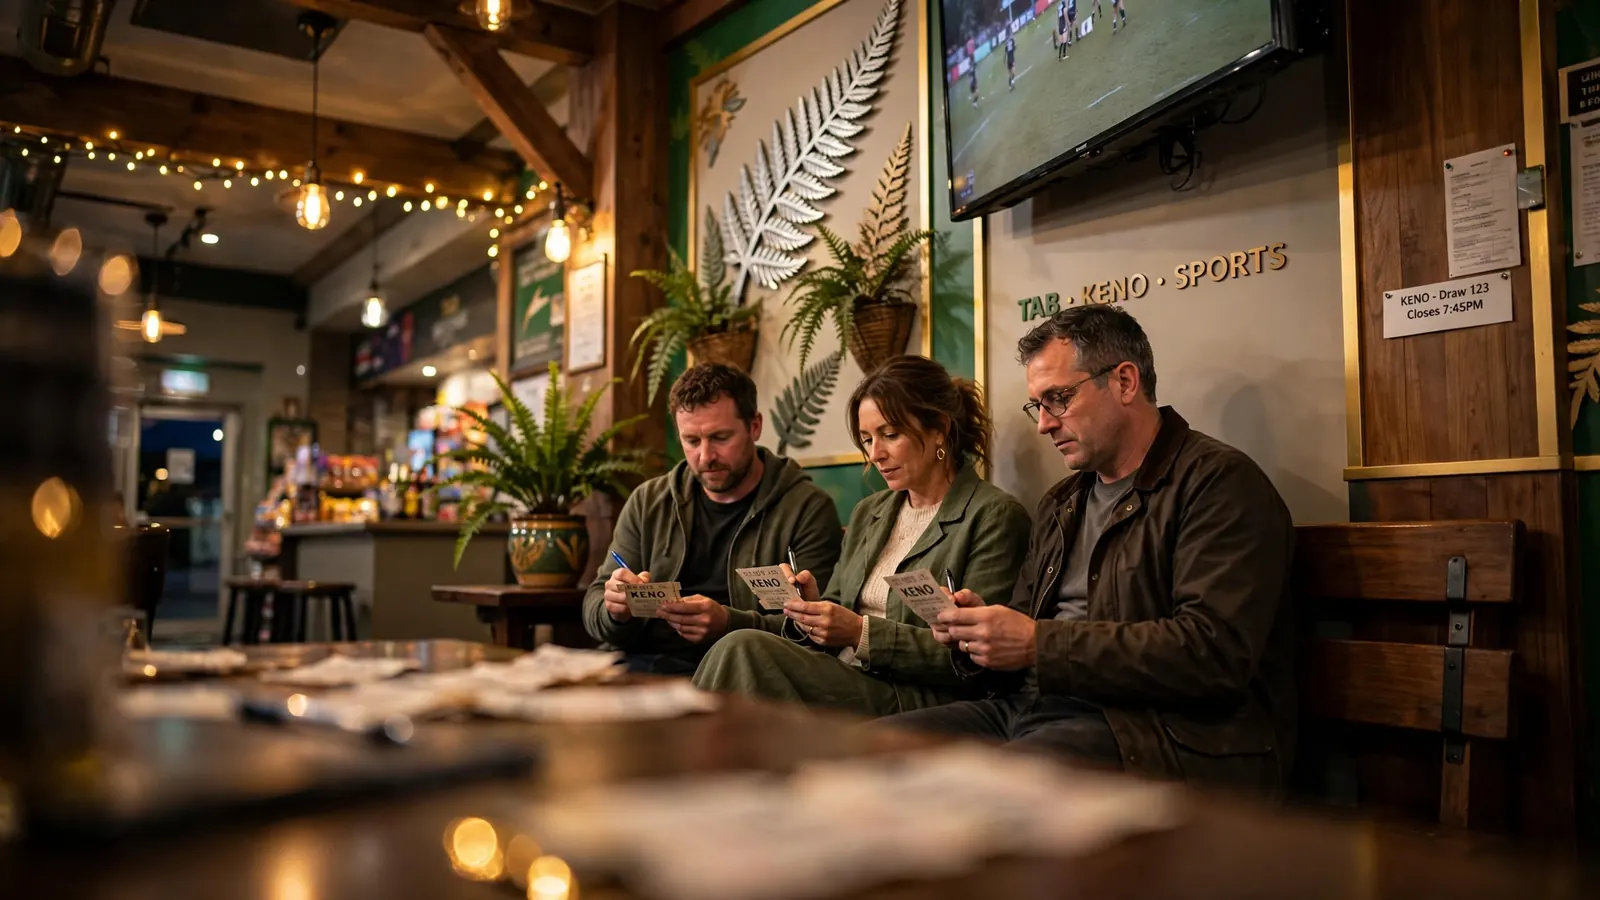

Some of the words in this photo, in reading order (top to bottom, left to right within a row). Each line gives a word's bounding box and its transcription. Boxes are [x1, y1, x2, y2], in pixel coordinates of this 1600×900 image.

[1018, 292, 1060, 321] TAB
[1081, 272, 1149, 304] KENO
[1174, 242, 1287, 290] SPORTS
[1400, 292, 1430, 306] KENO
[1439, 287, 1467, 300] Draw
[1470, 283, 1489, 295] 123
[1407, 307, 1440, 319] Closes
[1443, 299, 1483, 314] 7:45PM
[749, 578, 781, 588] KENO
[900, 584, 934, 597] KENO
